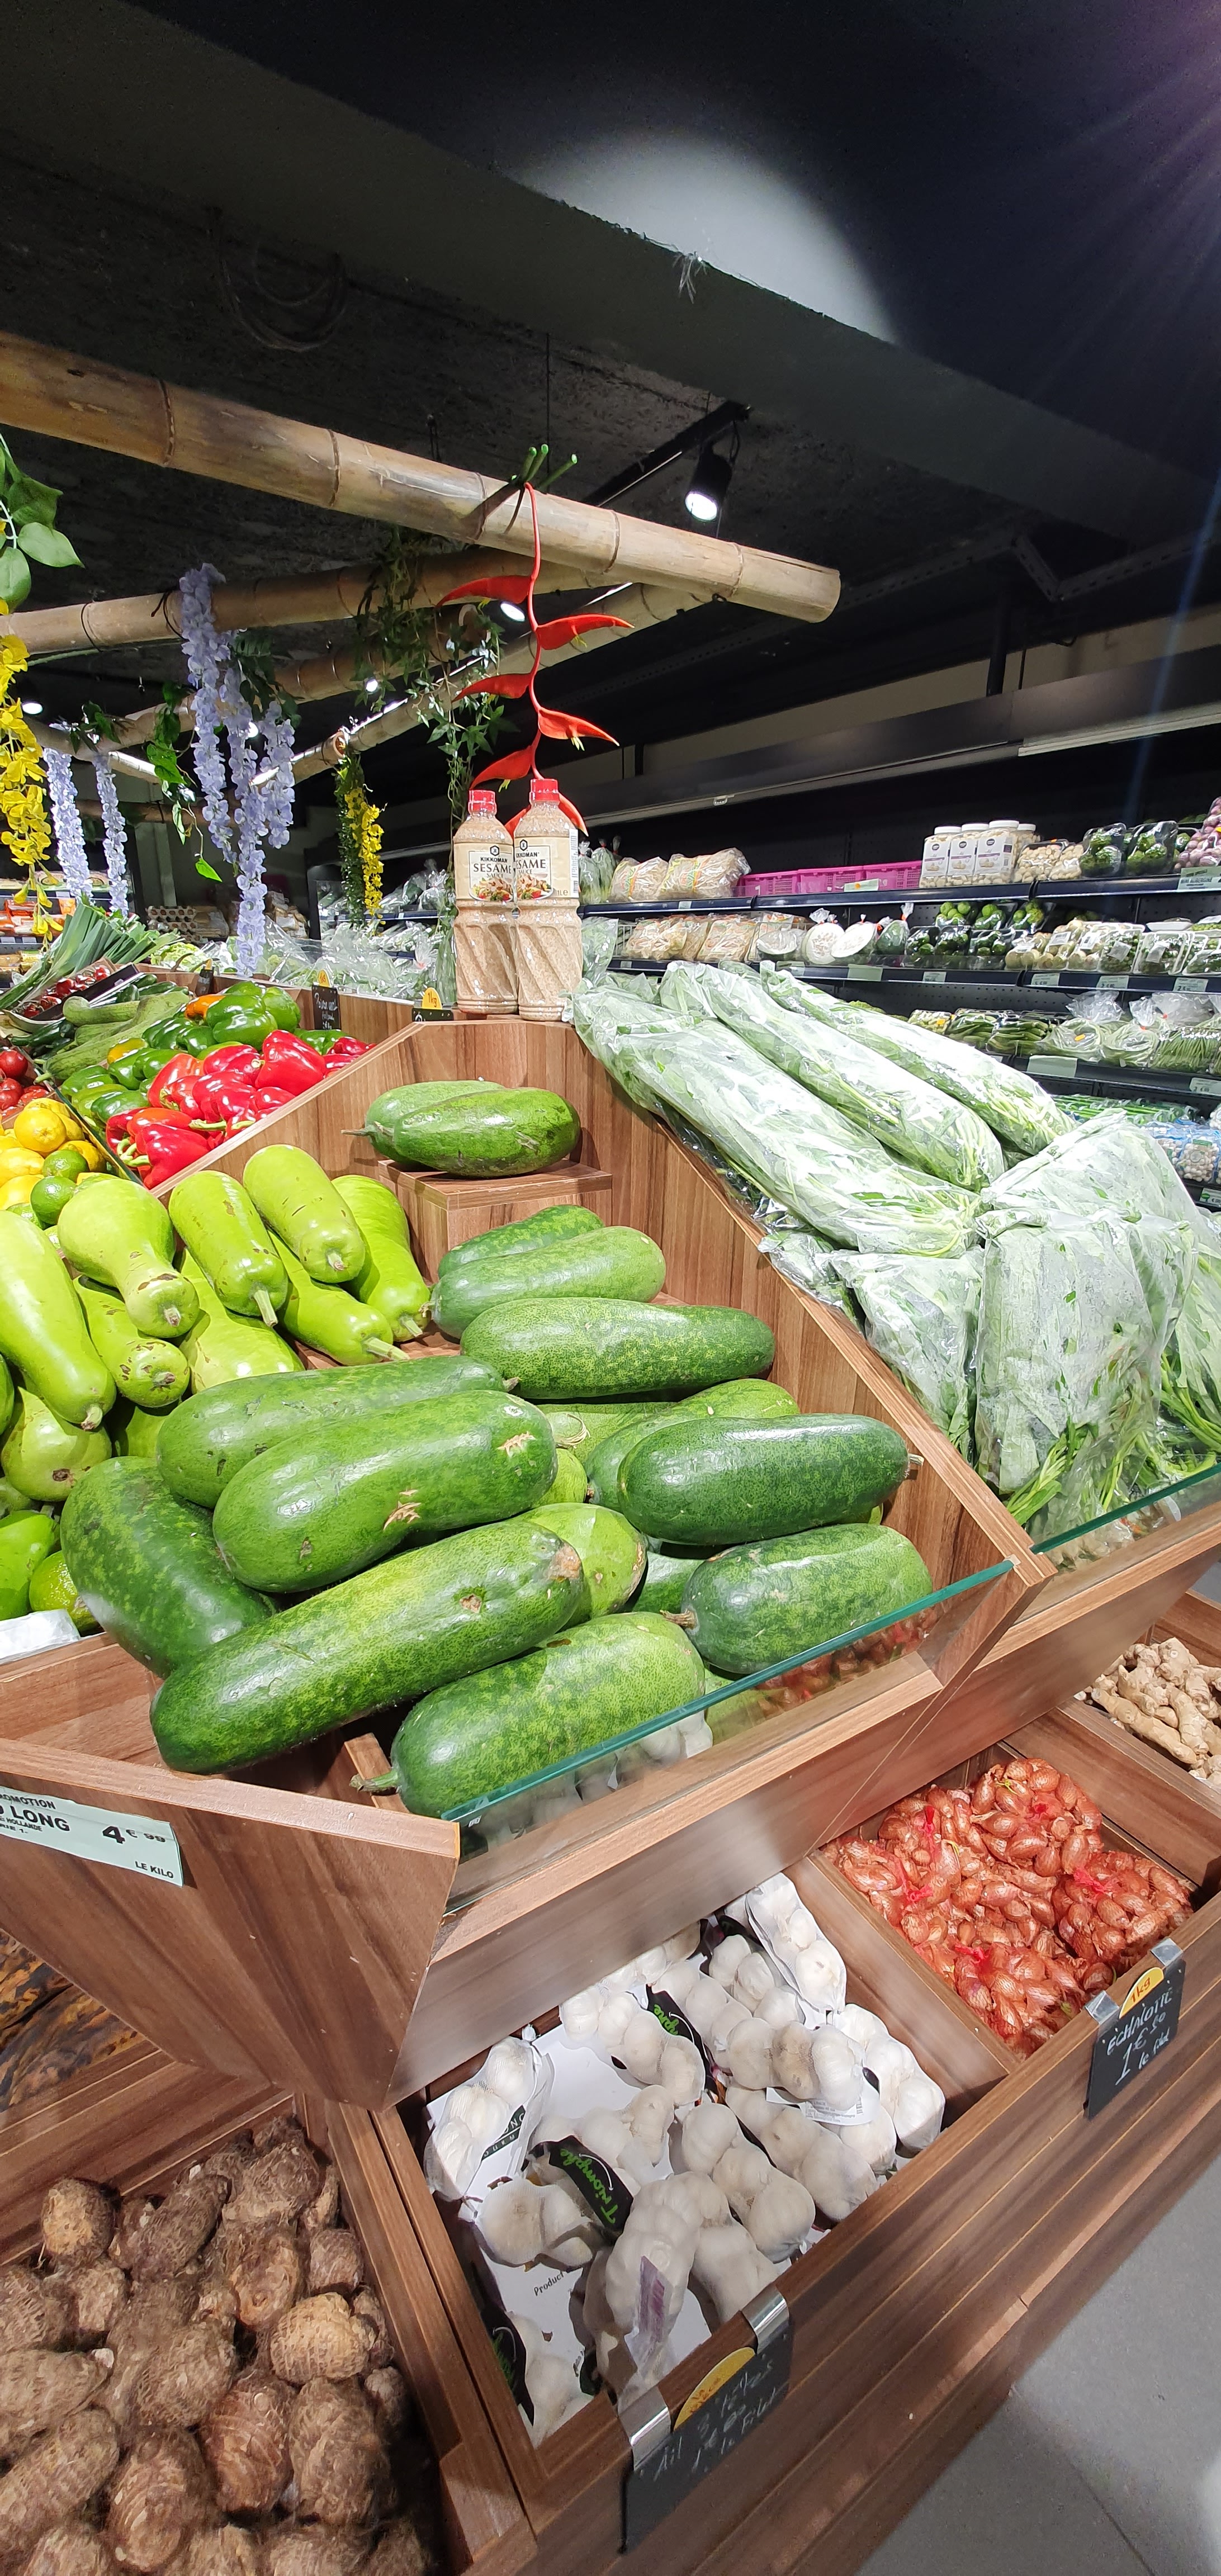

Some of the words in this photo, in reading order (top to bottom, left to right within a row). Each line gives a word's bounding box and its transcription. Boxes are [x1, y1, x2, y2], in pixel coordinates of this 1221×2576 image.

[473, 863, 512, 874] SESAME
[428, 990, 437, 1008] 1kg
[10, 1805, 70, 1831] LONG
[135, 1860, 148, 1871] LE
[150, 1865, 174, 1878] KILO
[1130, 1977, 1151, 2003] 1kg
